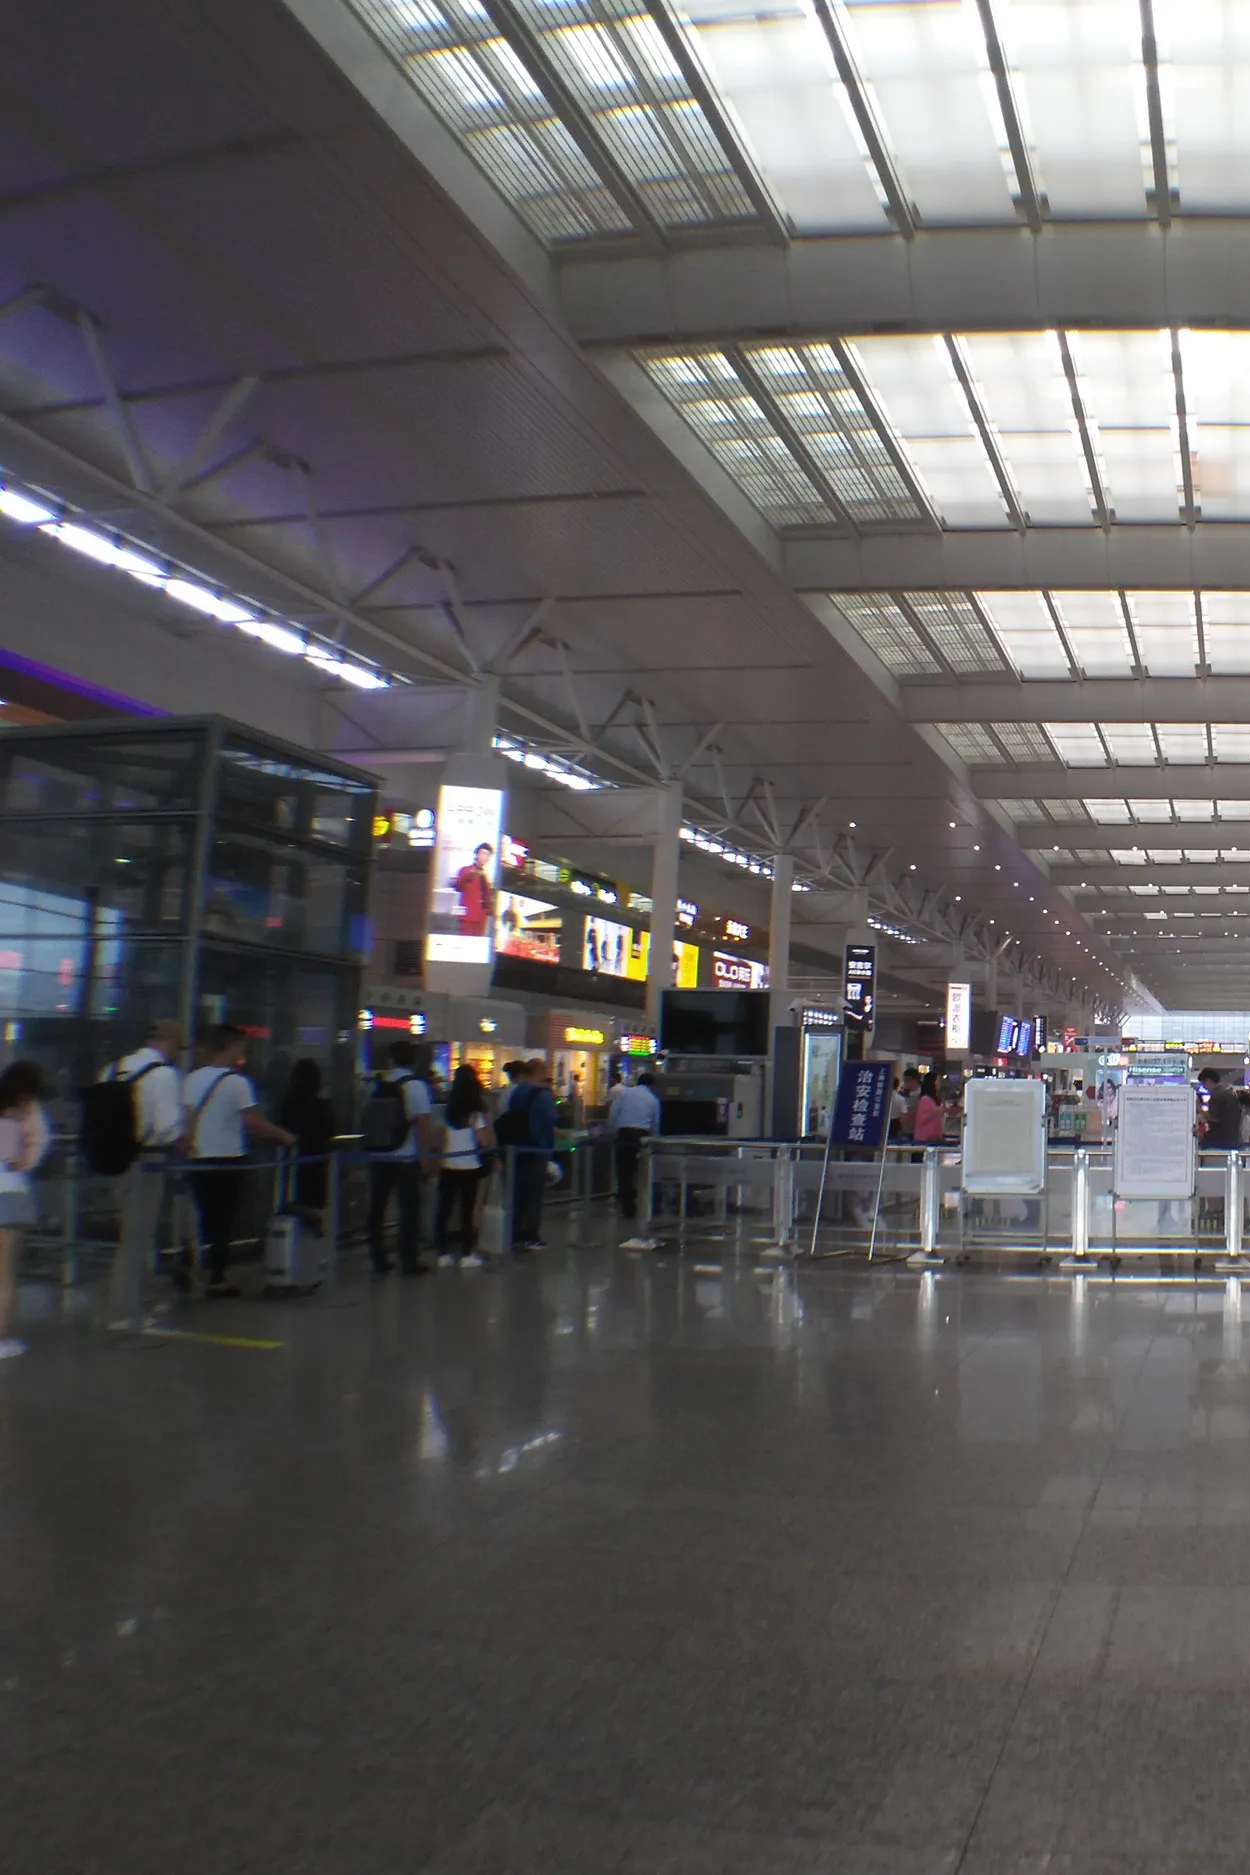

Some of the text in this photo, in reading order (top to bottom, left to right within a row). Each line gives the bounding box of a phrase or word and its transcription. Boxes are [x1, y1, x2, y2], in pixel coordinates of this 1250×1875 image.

[1129, 1065, 1162, 1073] Hisense
[848, 1069, 874, 1142] 治安检查站
